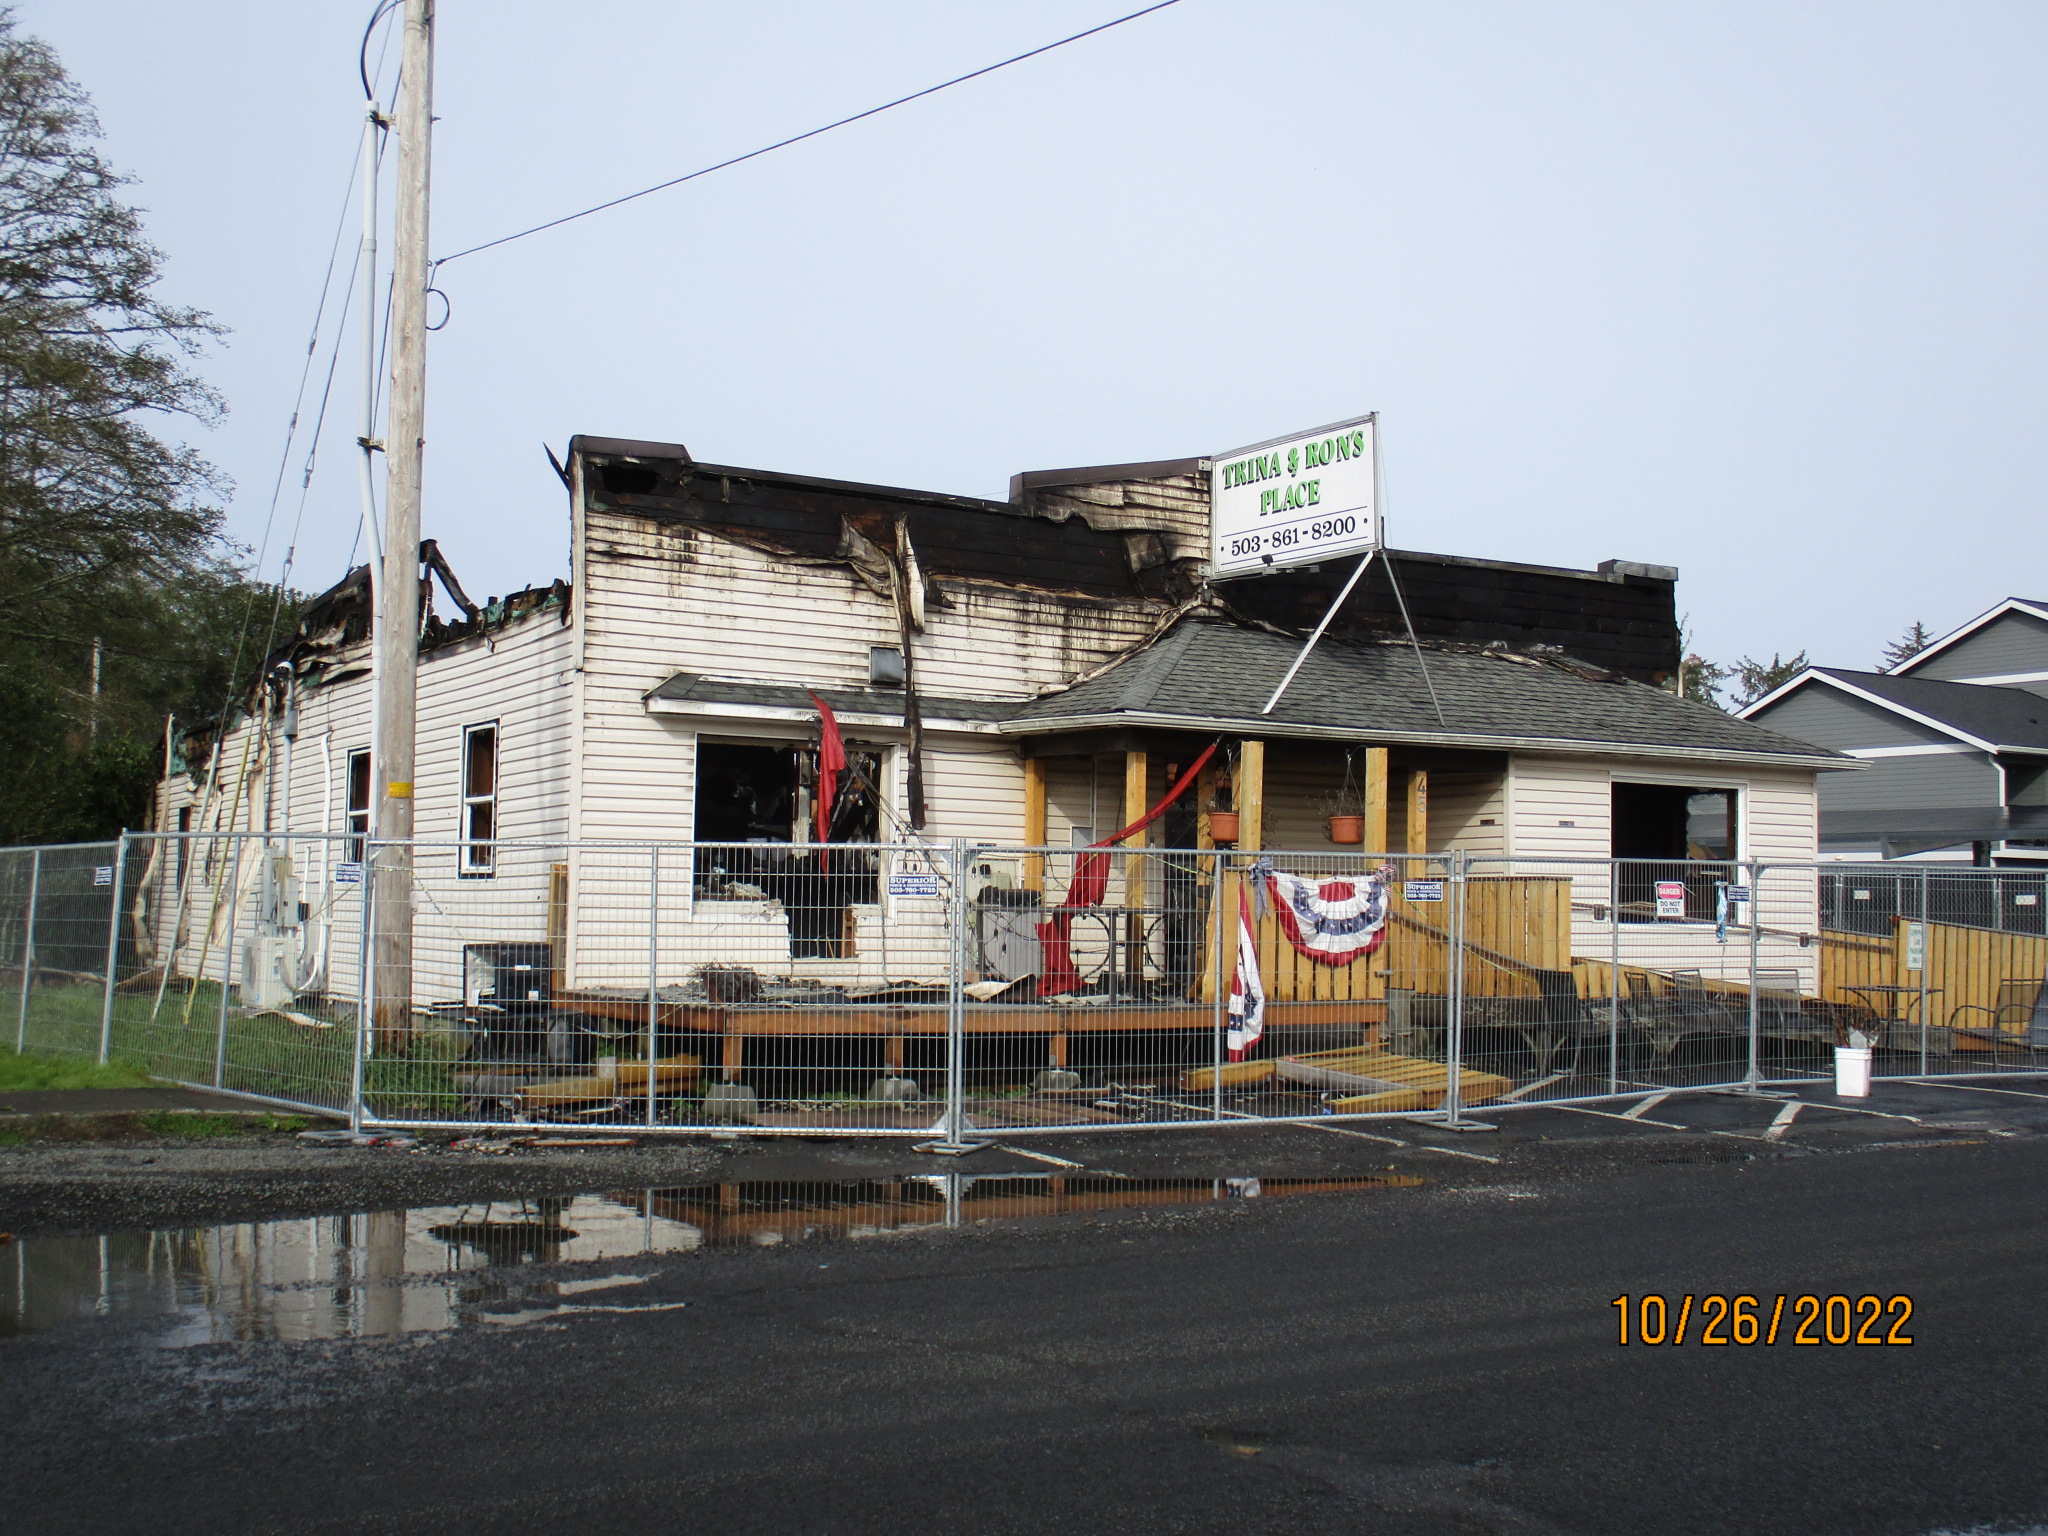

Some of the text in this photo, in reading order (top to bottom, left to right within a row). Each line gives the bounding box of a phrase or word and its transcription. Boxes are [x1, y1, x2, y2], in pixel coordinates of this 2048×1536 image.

[1222, 429, 1366, 490] TRINA & RON'S
[1259, 478, 1321, 516] PLACE
[1231, 516, 1356, 557] 503-861-8200
[890, 876, 937, 884] SUPERIOR
[1658, 887, 1681, 895] DANGER
